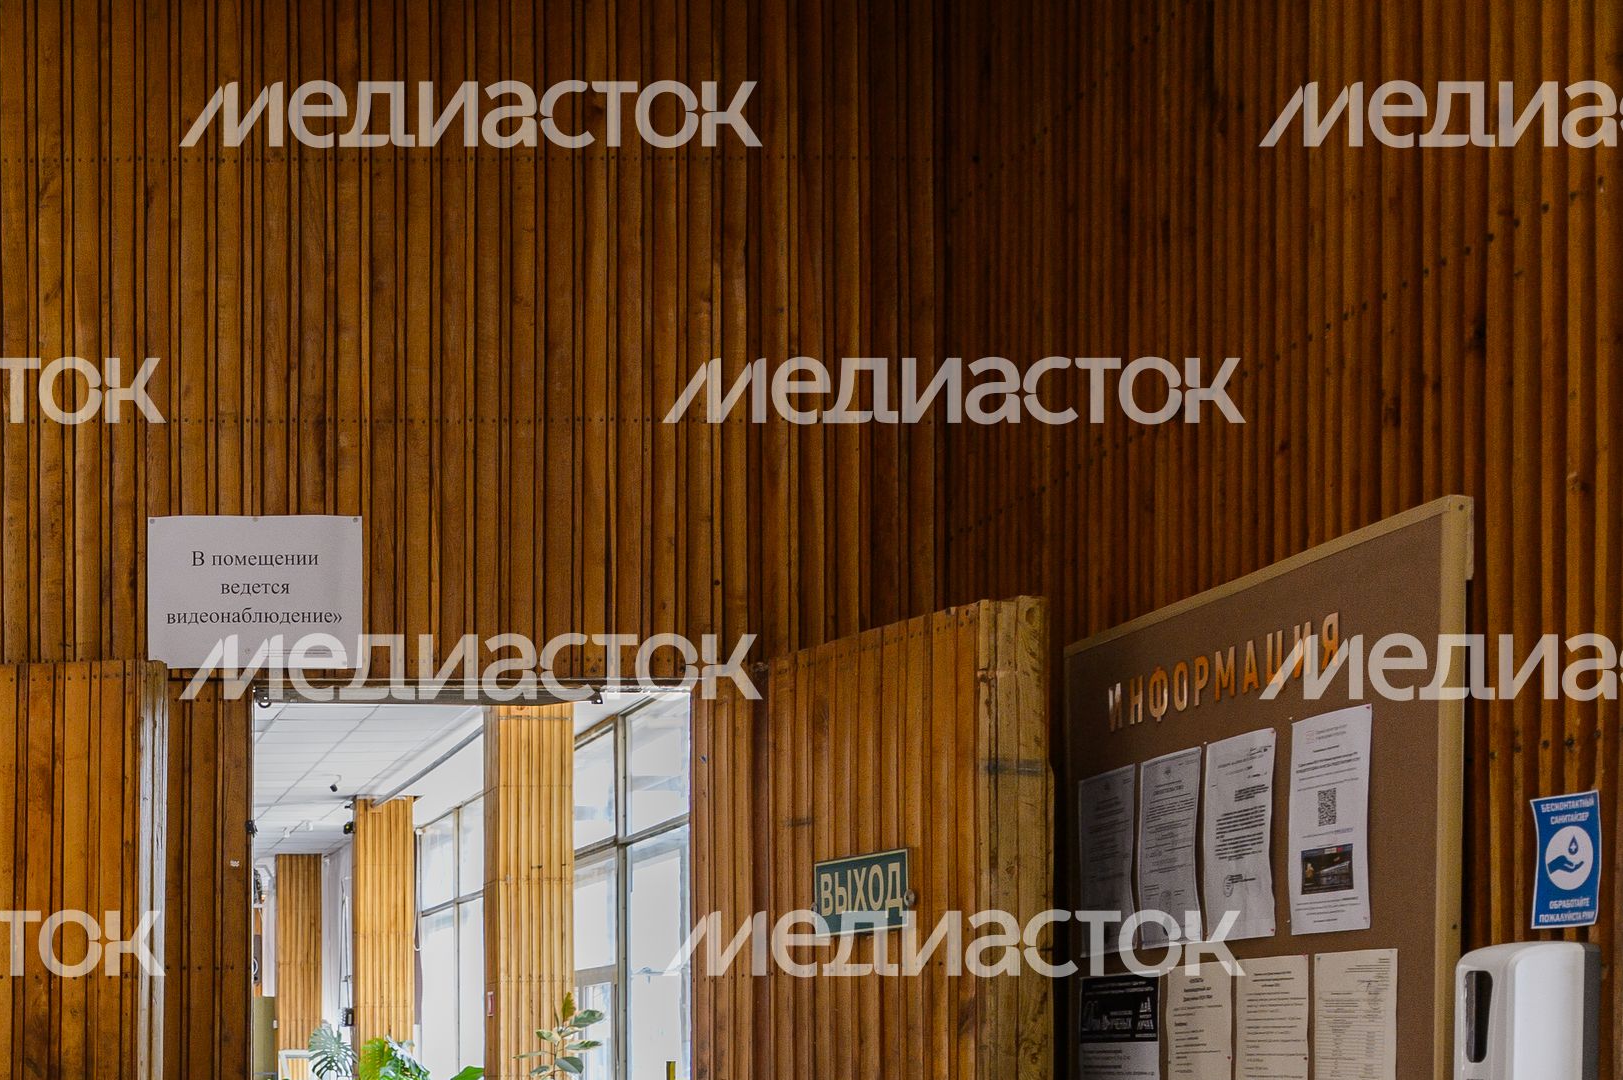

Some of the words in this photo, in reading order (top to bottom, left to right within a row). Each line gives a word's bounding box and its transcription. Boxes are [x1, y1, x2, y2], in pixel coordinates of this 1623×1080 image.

[191, 551, 205, 566] В
[212, 552, 319, 567] помещении
[220, 581, 290, 595] ведется
[166, 607, 343, 625] видеонаблюдение»
[1108, 612, 1339, 732] ИНФОРМАЦИЯ
[820, 862, 903, 918] ВЫХОД
